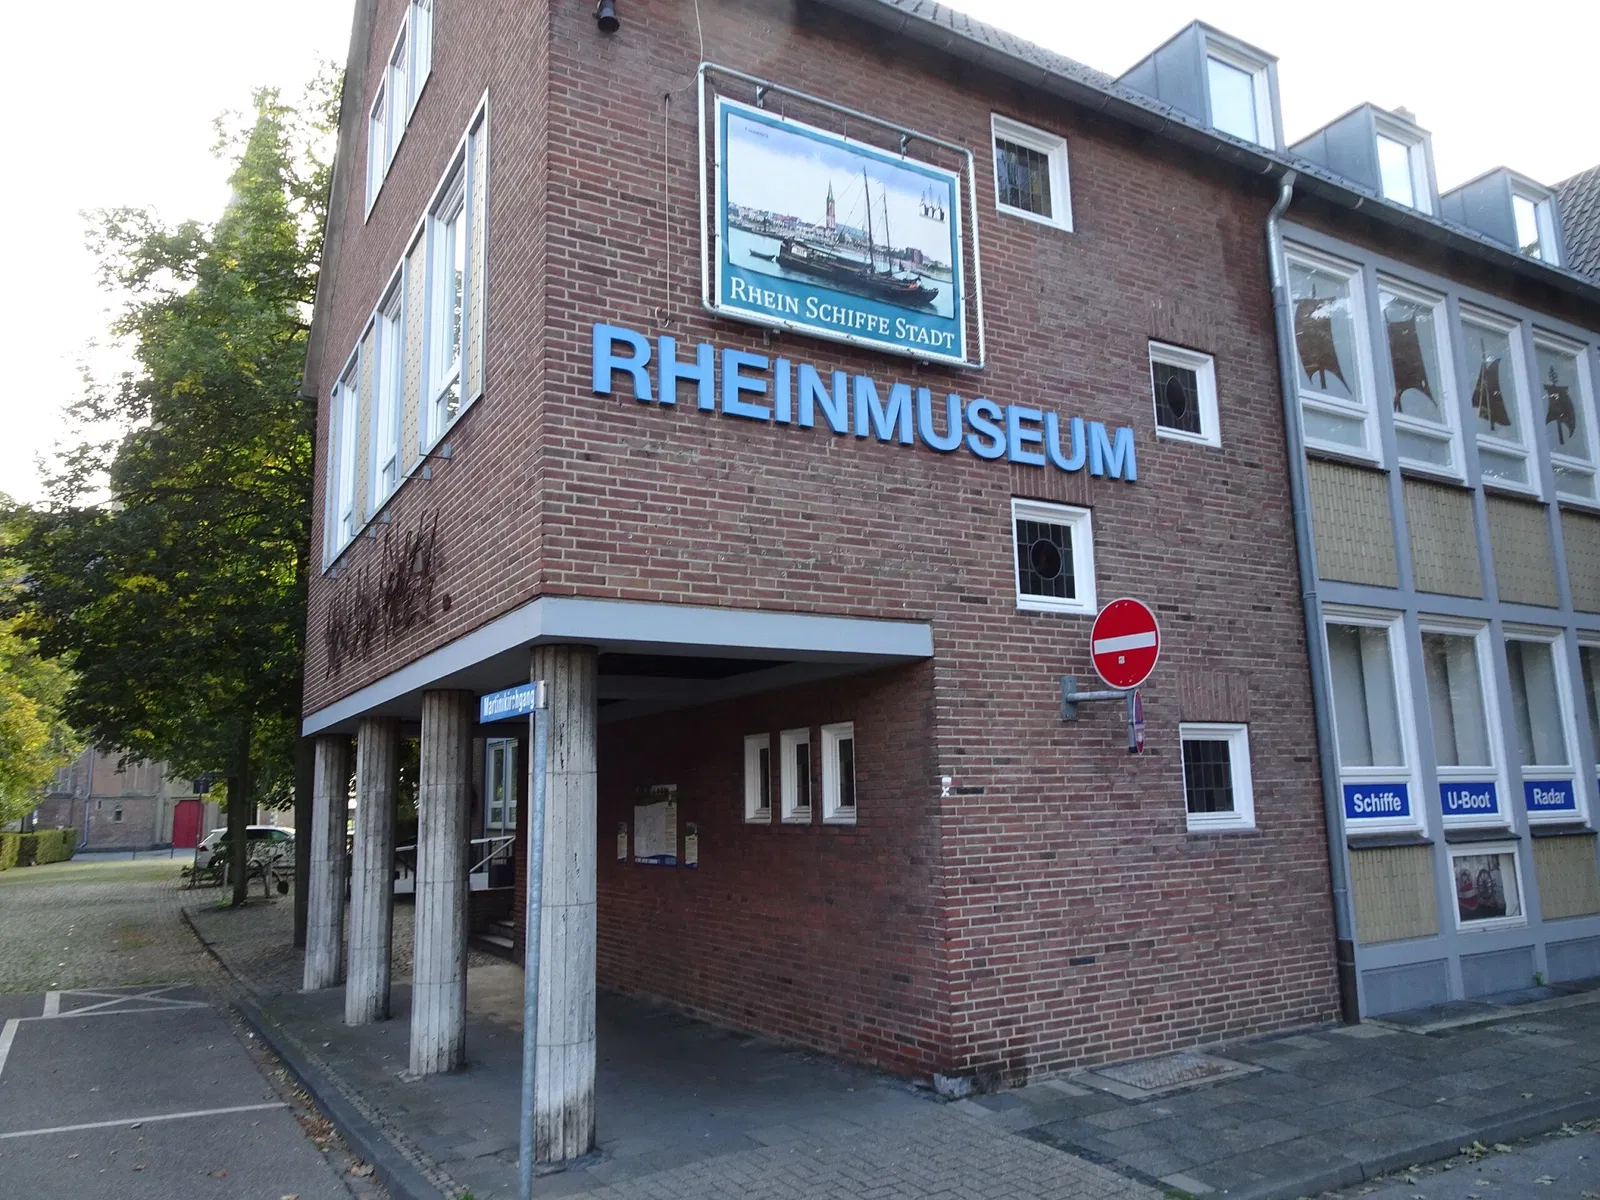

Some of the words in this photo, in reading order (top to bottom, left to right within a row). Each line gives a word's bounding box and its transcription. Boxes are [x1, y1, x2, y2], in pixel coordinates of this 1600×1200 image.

[730, 276, 799, 315] RHEIN
[805, 296, 890, 336] SCHIFFE
[895, 317, 955, 349] STADT
[592, 322, 1138, 482] RHEINMUSEUM
[1353, 792, 1402, 813] Schiffe
[1447, 790, 1492, 809] U-Boot
[1533, 787, 1566, 805] Radar
